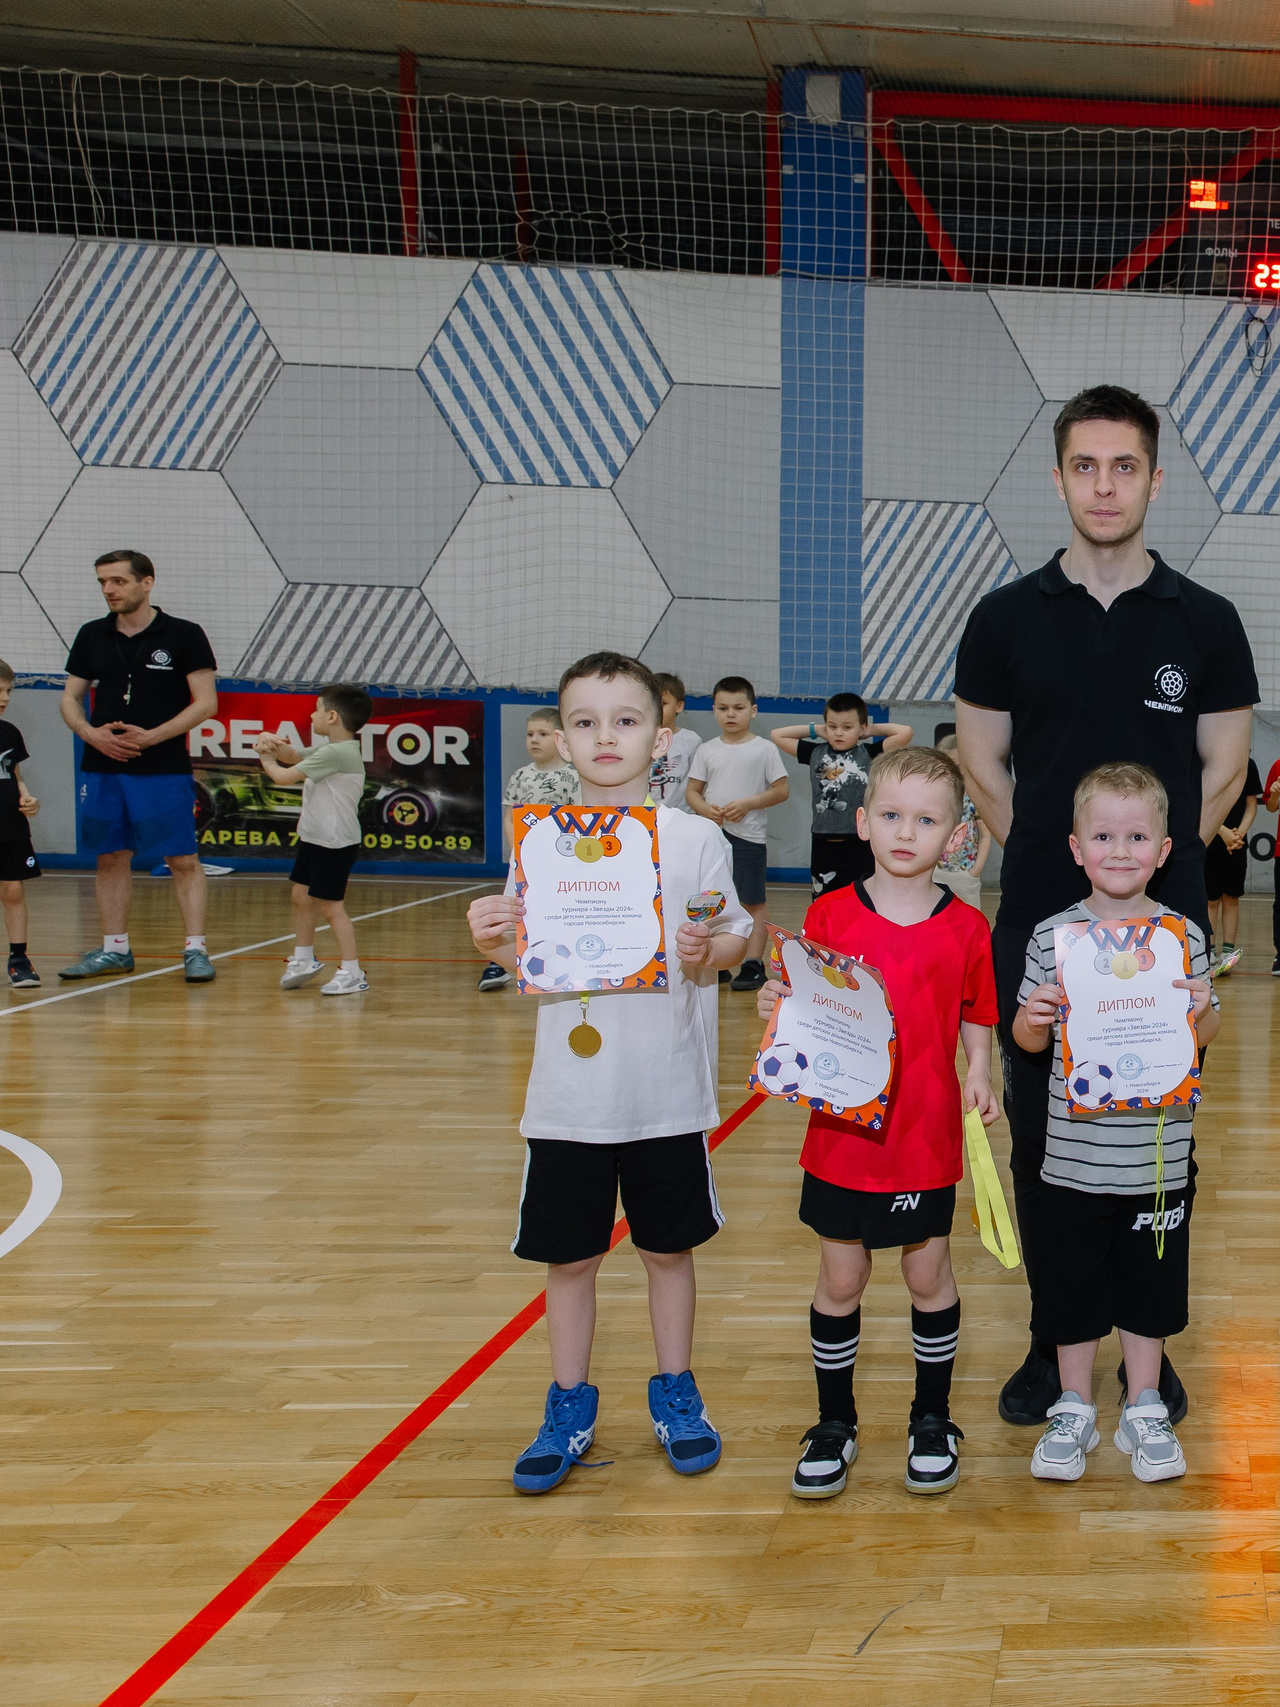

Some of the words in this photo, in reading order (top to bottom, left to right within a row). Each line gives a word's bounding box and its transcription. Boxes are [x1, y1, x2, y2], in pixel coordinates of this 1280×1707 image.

[1205, 247, 1238, 258] ФОЛЫ
[189, 718, 470, 766] REATOR
[195, 830, 281, 847] АРЕВА
[557, 881, 621, 894] ДИПЛОМ
[813, 993, 863, 1021] ДИПЛОМ
[1097, 997, 1156, 1014] ДИПЛОМ
[1102, 1026, 1126, 1034] турнира
[1127, 1023, 1151, 1031] «Звезды
[1132, 1200, 1184, 1231] PUB
